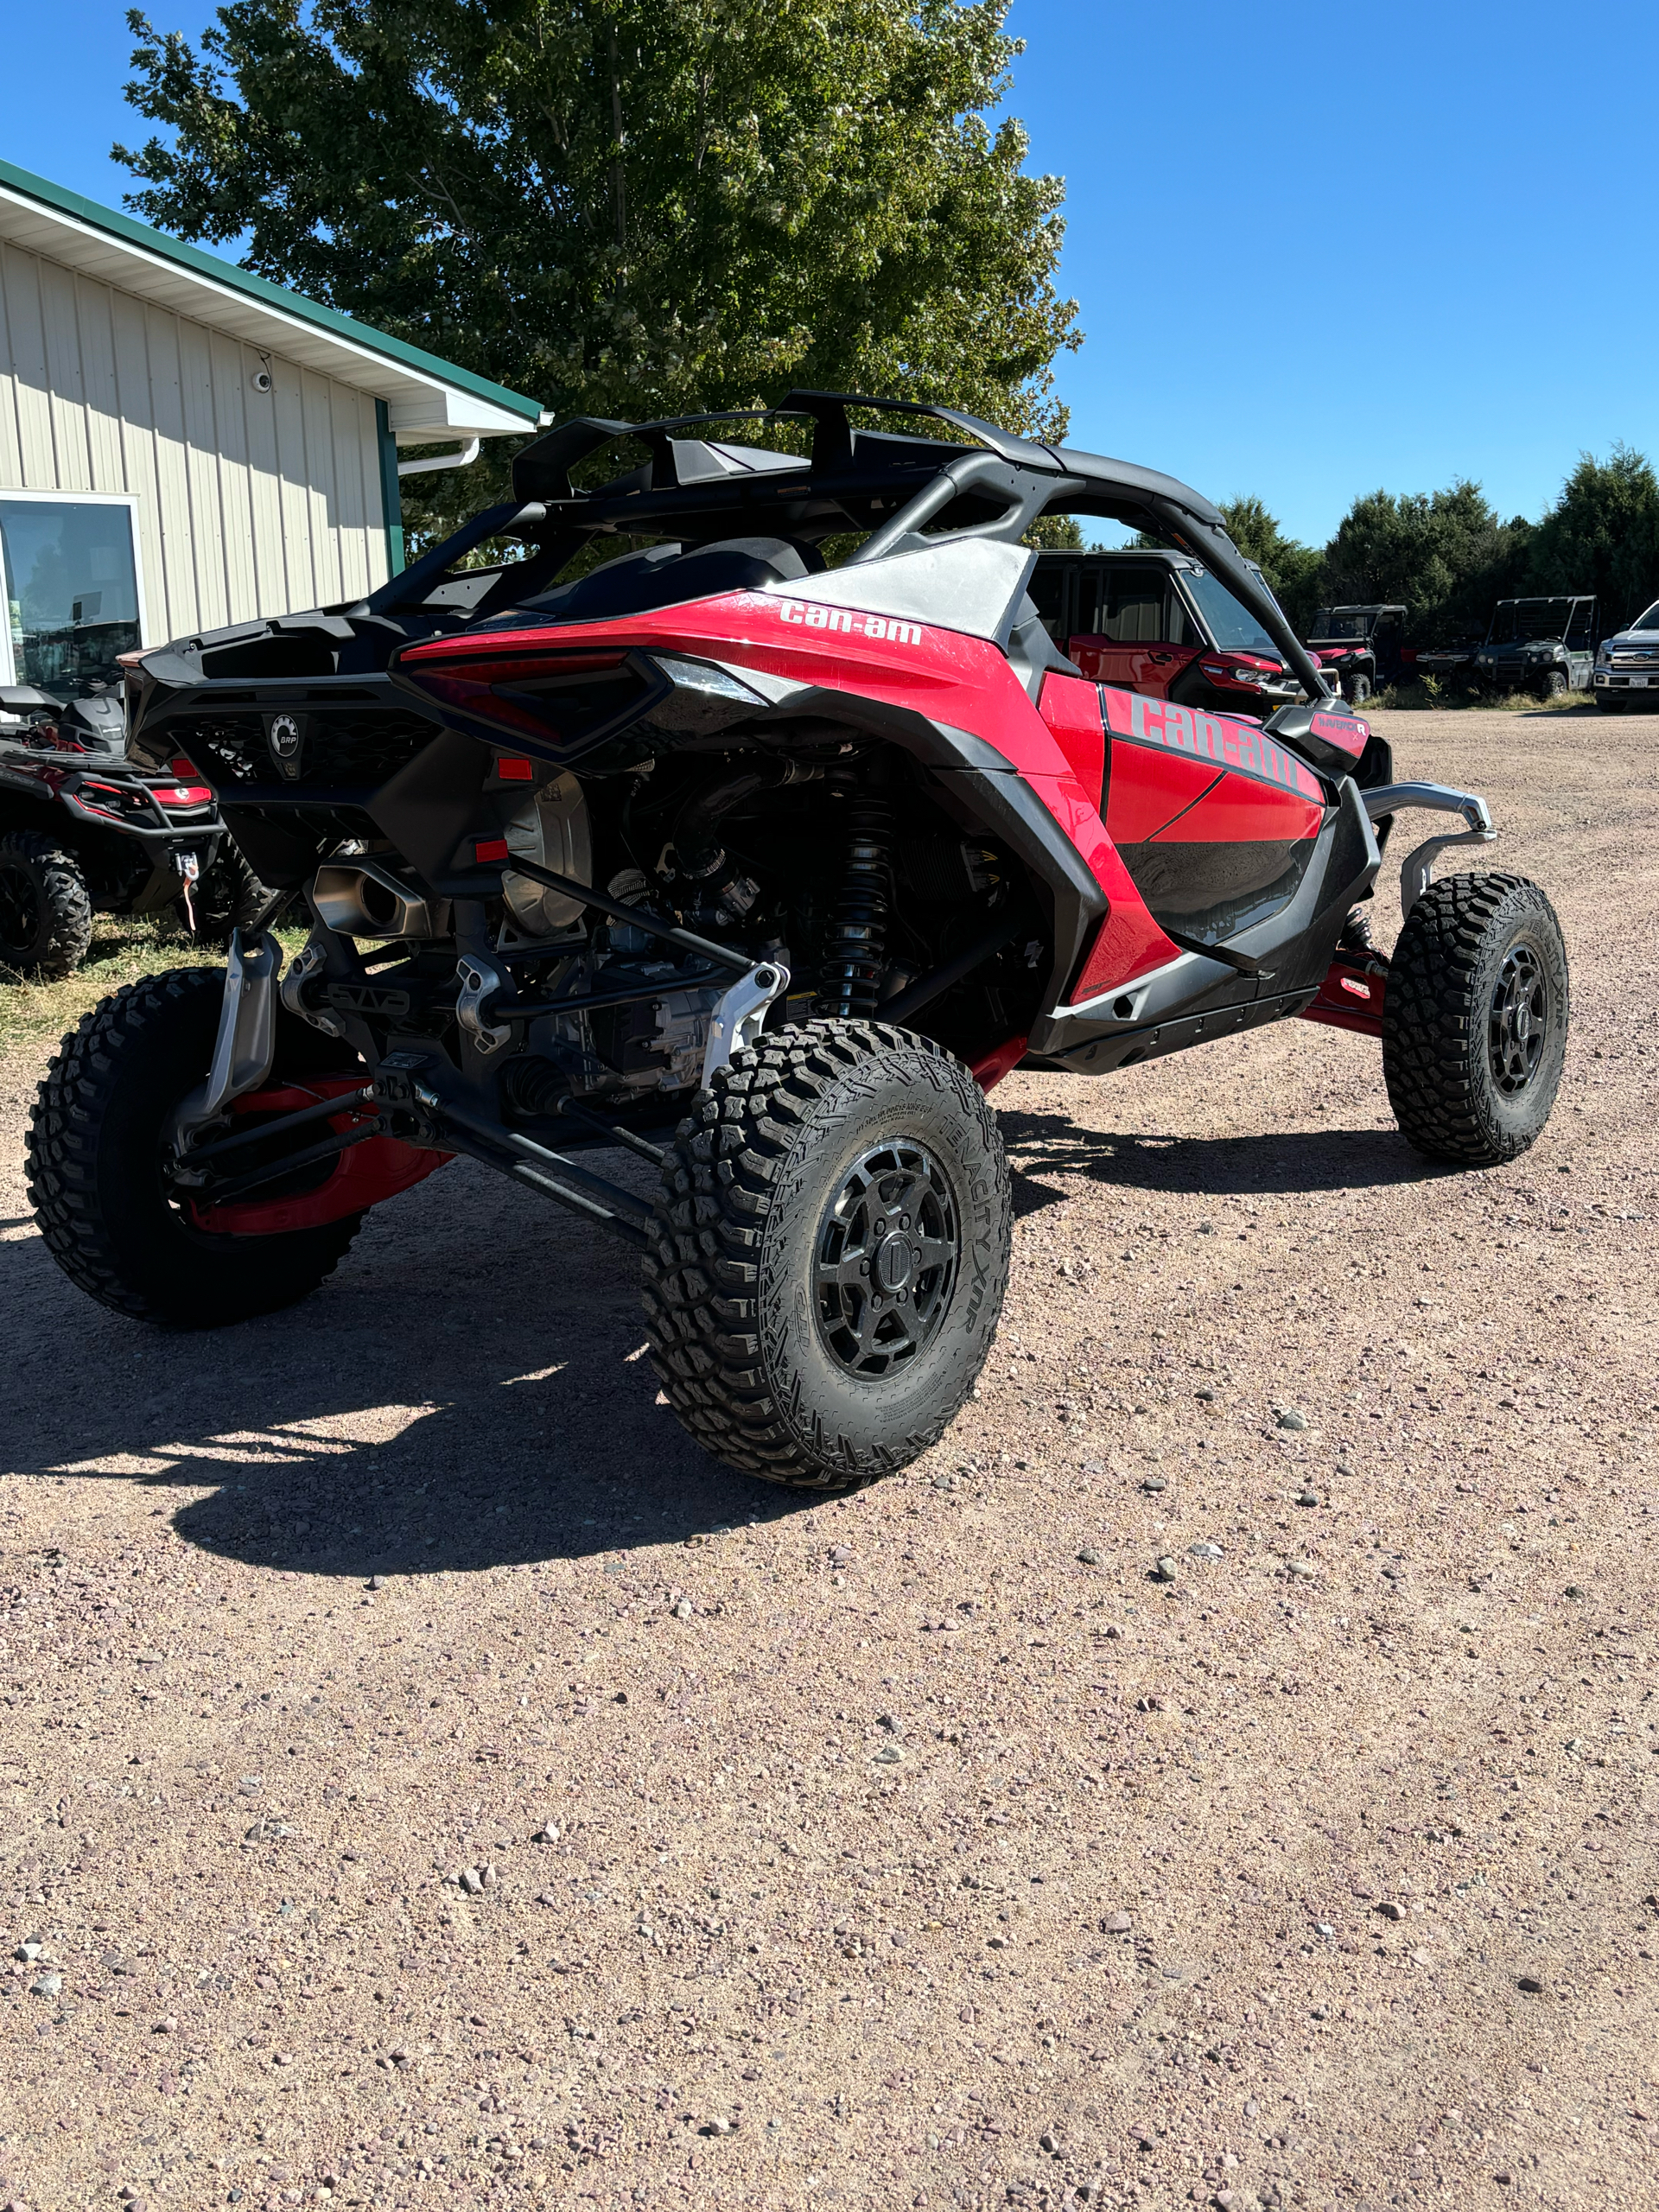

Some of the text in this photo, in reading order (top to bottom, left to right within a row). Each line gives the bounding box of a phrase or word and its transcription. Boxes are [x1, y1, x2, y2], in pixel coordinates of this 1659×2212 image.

[779, 601, 922, 645] can-am
[1131, 694, 1298, 788] can-am
[940, 1114, 991, 1252] TENACITY
